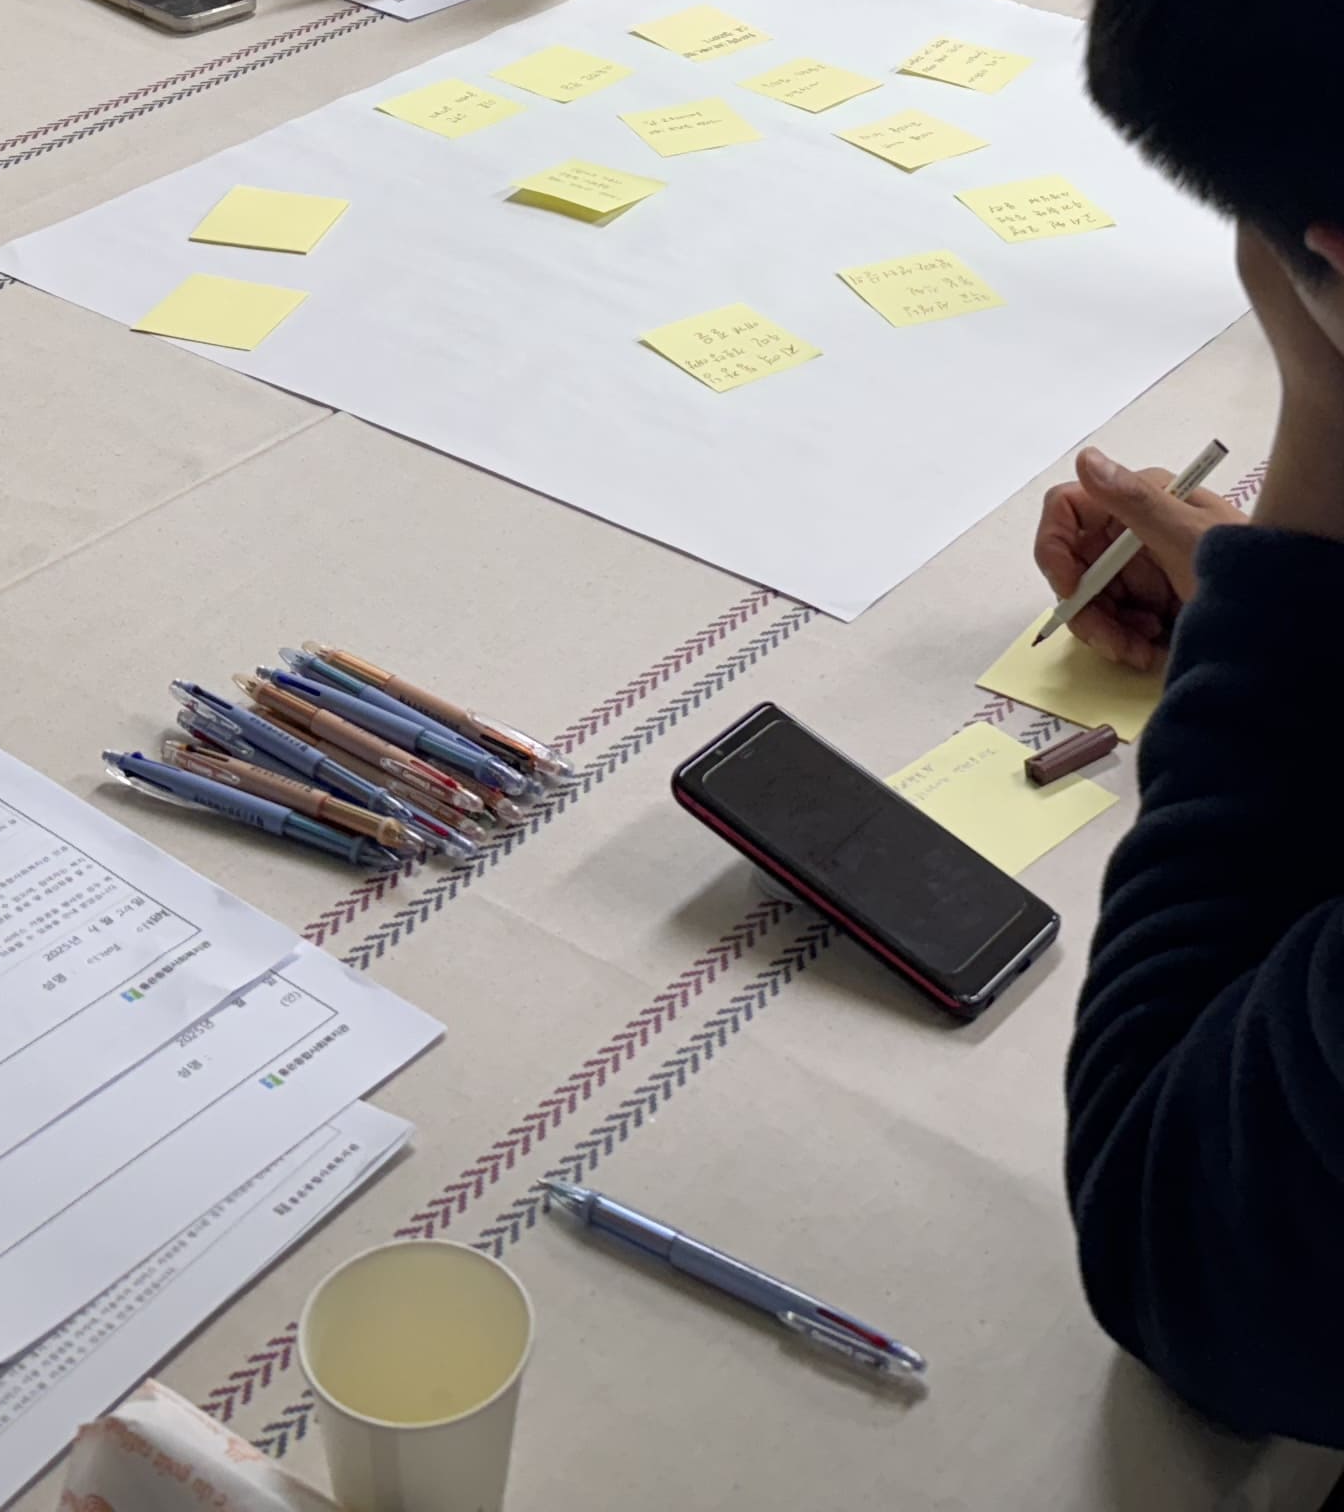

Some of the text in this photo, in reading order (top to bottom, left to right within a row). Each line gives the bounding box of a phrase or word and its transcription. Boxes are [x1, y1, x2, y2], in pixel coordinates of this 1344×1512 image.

[41, 935, 82, 961] 2025년
[139, 941, 212, 989] 좋은종합사회복지관
[41, 972, 68, 990] 성명
[176, 1019, 215, 1049] 2025년
[278, 1024, 350, 1077] 좋은종합사회복지관
[177, 1059, 202, 1079] 성명
